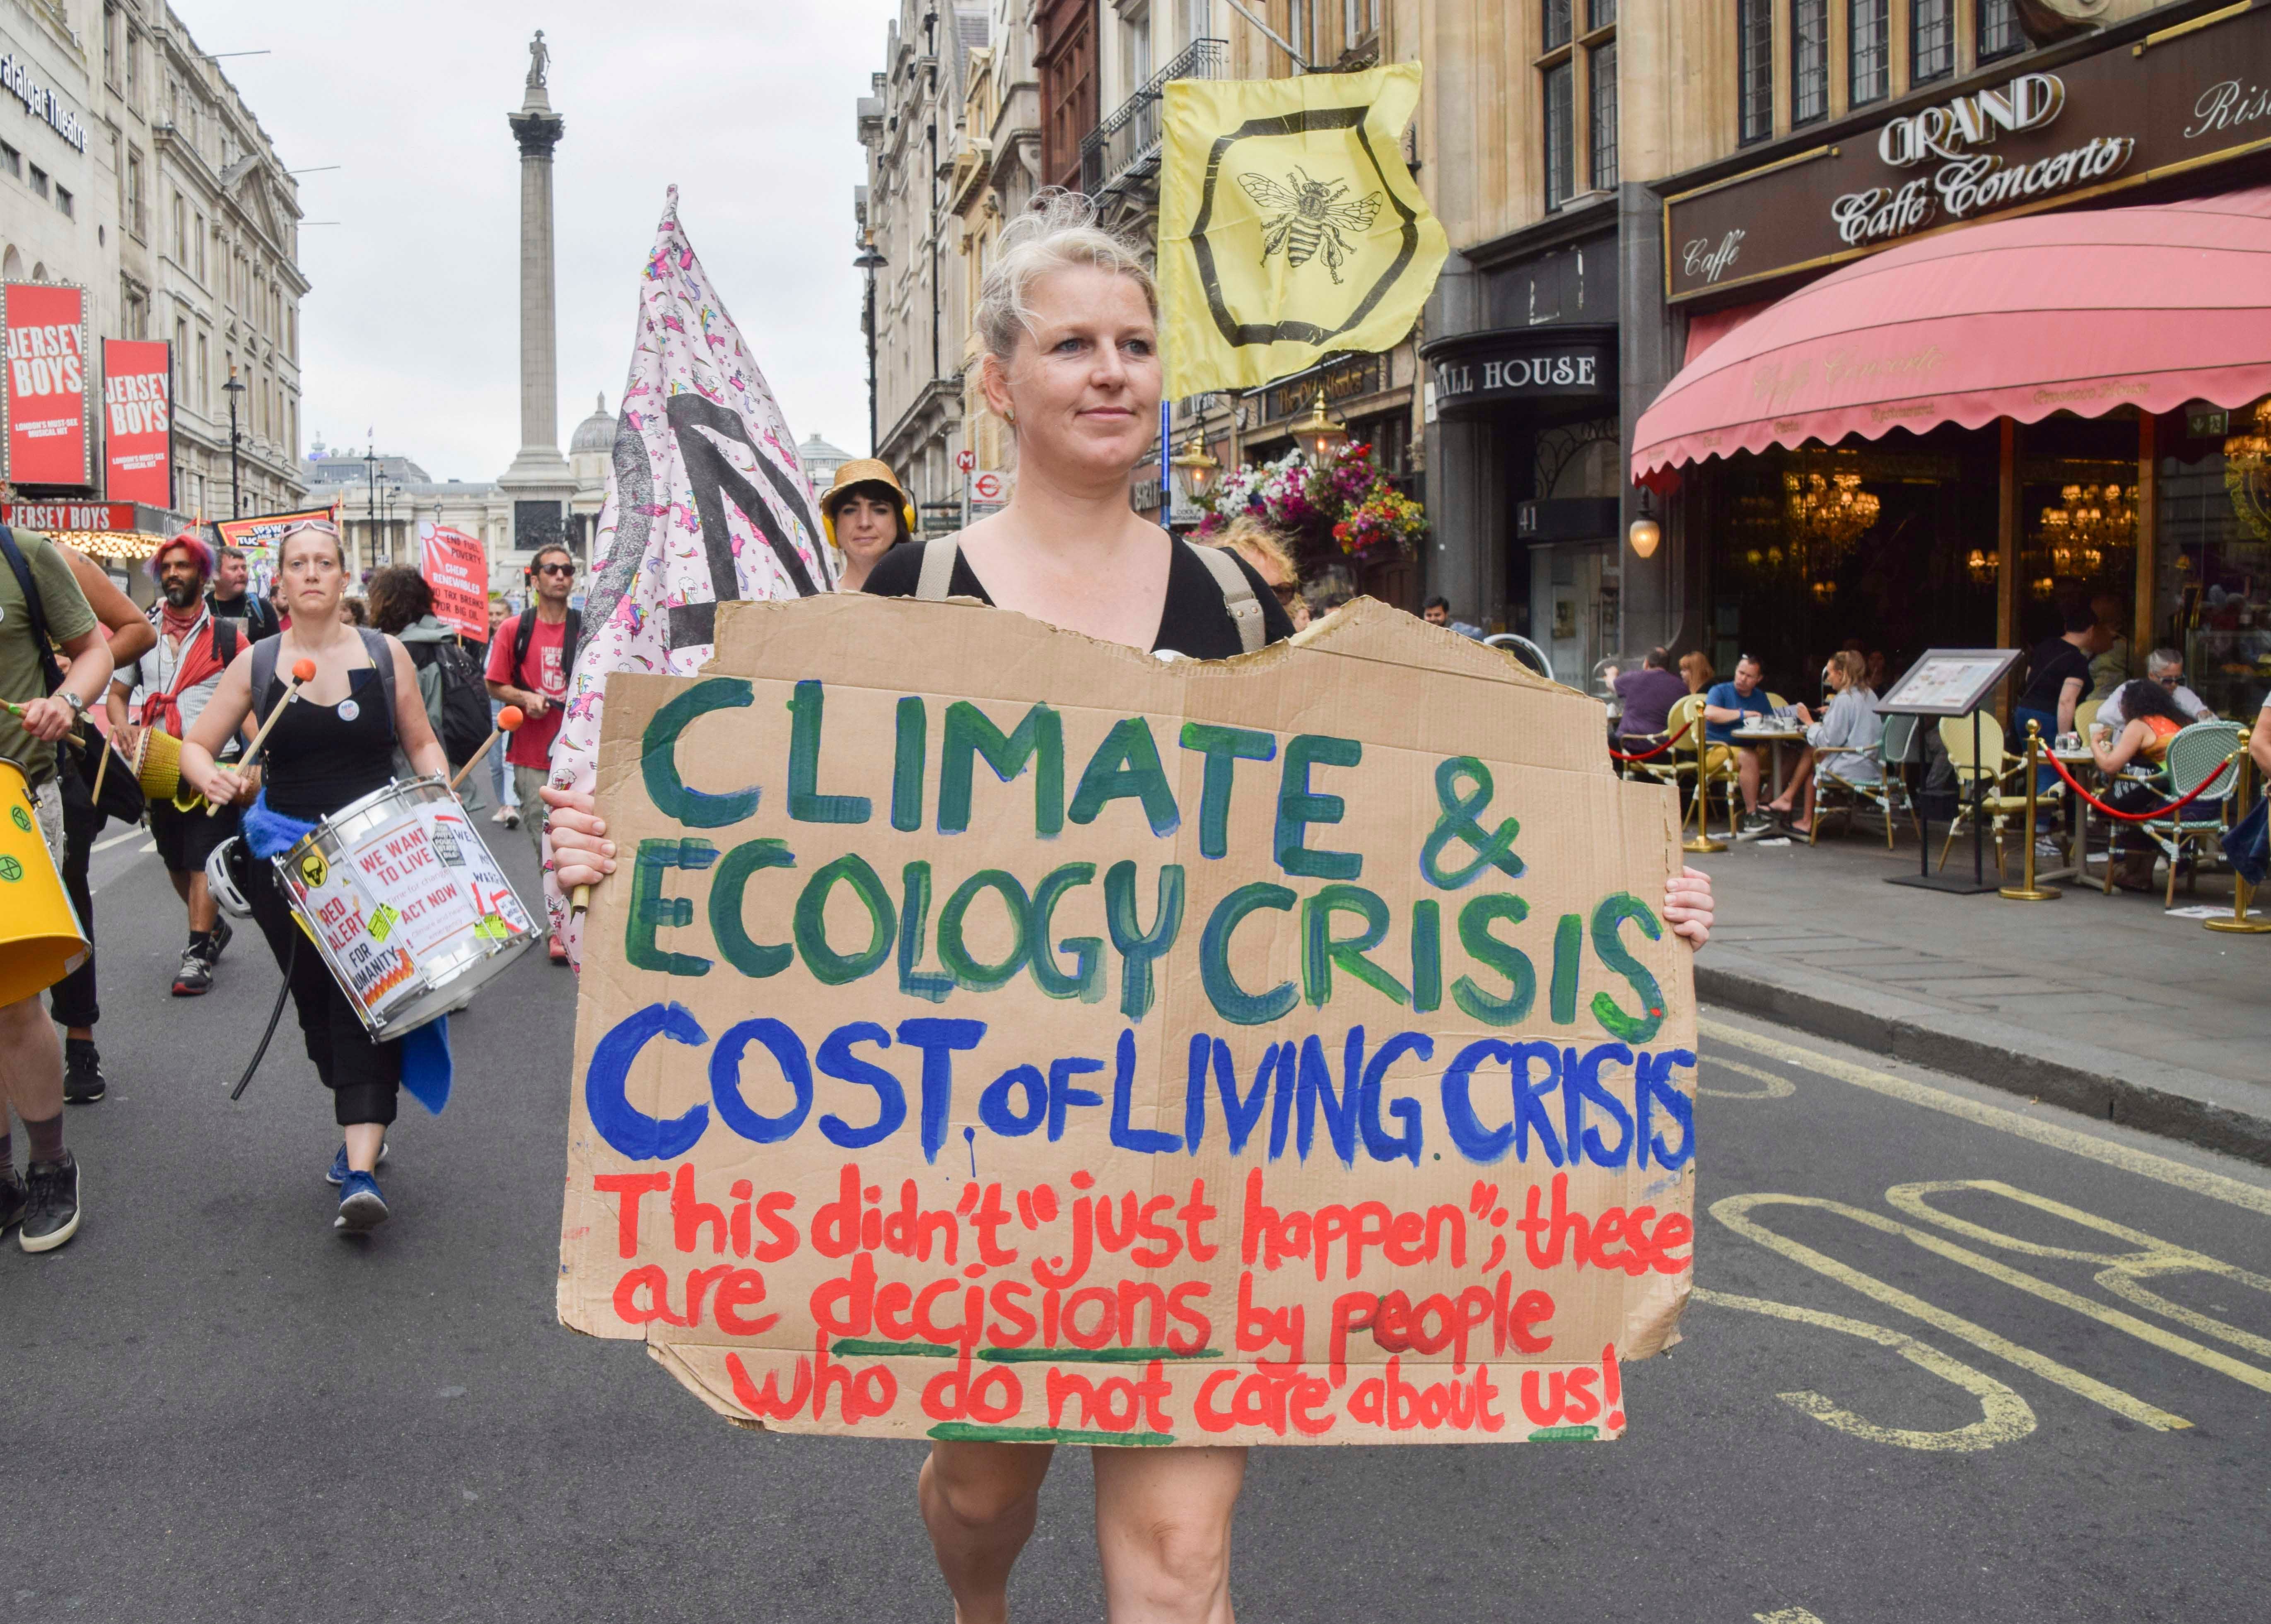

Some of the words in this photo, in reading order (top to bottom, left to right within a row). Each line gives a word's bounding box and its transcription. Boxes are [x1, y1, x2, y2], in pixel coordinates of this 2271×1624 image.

[46, 89, 88, 154] Theatre
[1879, 73, 2065, 166] GRAND
[1935, 137, 2134, 217] Concerto
[7, 323, 82, 359] JERSEY
[12, 355, 82, 397] BOYS
[106, 372, 169, 404] JERSEY
[1483, 356, 1596, 389] HOUSE
[110, 399, 169, 436] BOYS
[959, 453, 974, 468] M
[7, 506, 65, 529] JERSEY
[70, 506, 110, 530] BOYS
[1519, 506, 1535, 530] 41
[237, 536, 259, 546] TUC
[447, 535, 461, 546] END
[464, 540, 479, 553] FUEL
[451, 547, 481, 565] POVERTY
[432, 571, 480, 595] RENEWABLES
[444, 590, 457, 600] TAX
[460, 593, 484, 610] BREAKS
[455, 605, 467, 616] BIG
[469, 610, 479, 620] OIL
[640, 677, 1363, 880] CLIMATE
[1419, 756, 1528, 891] &
[359, 849, 387, 874] WE
[385, 827, 428, 858] WANT
[377, 865, 399, 886] TO
[398, 847, 434, 874] LIVE
[319, 896, 346, 928] RED
[401, 899, 426, 924] ACT
[427, 883, 458, 908] NOW
[328, 910, 367, 954] ALERT
[625, 837, 1185, 1024] ECOLOGY
[1199, 882, 1668, 1045] CRISIS
[349, 943, 372, 968] FOR
[585, 1000, 987, 1166] COST
[978, 1057, 1106, 1142] OF
[1109, 1024, 1435, 1171] LIVING
[1441, 1038, 1697, 1172] CRISIS
[594, 1163, 801, 1263] This
[811, 1163, 1018, 1267] didn't
[1516, 1172, 1694, 1276] these
[612, 1264, 784, 1336] are
[809, 1252, 1213, 1356] decisions
[1235, 1270, 1306, 1375] by
[1329, 1270, 1556, 1388] people
[725, 1327, 898, 1425] who
[920, 1330, 1023, 1424] do
[1045, 1358, 1174, 1434] not
[1193, 1368, 1339, 1436] care
[1347, 1355, 1506, 1432] about
[1520, 1342, 1626, 1431] us!
